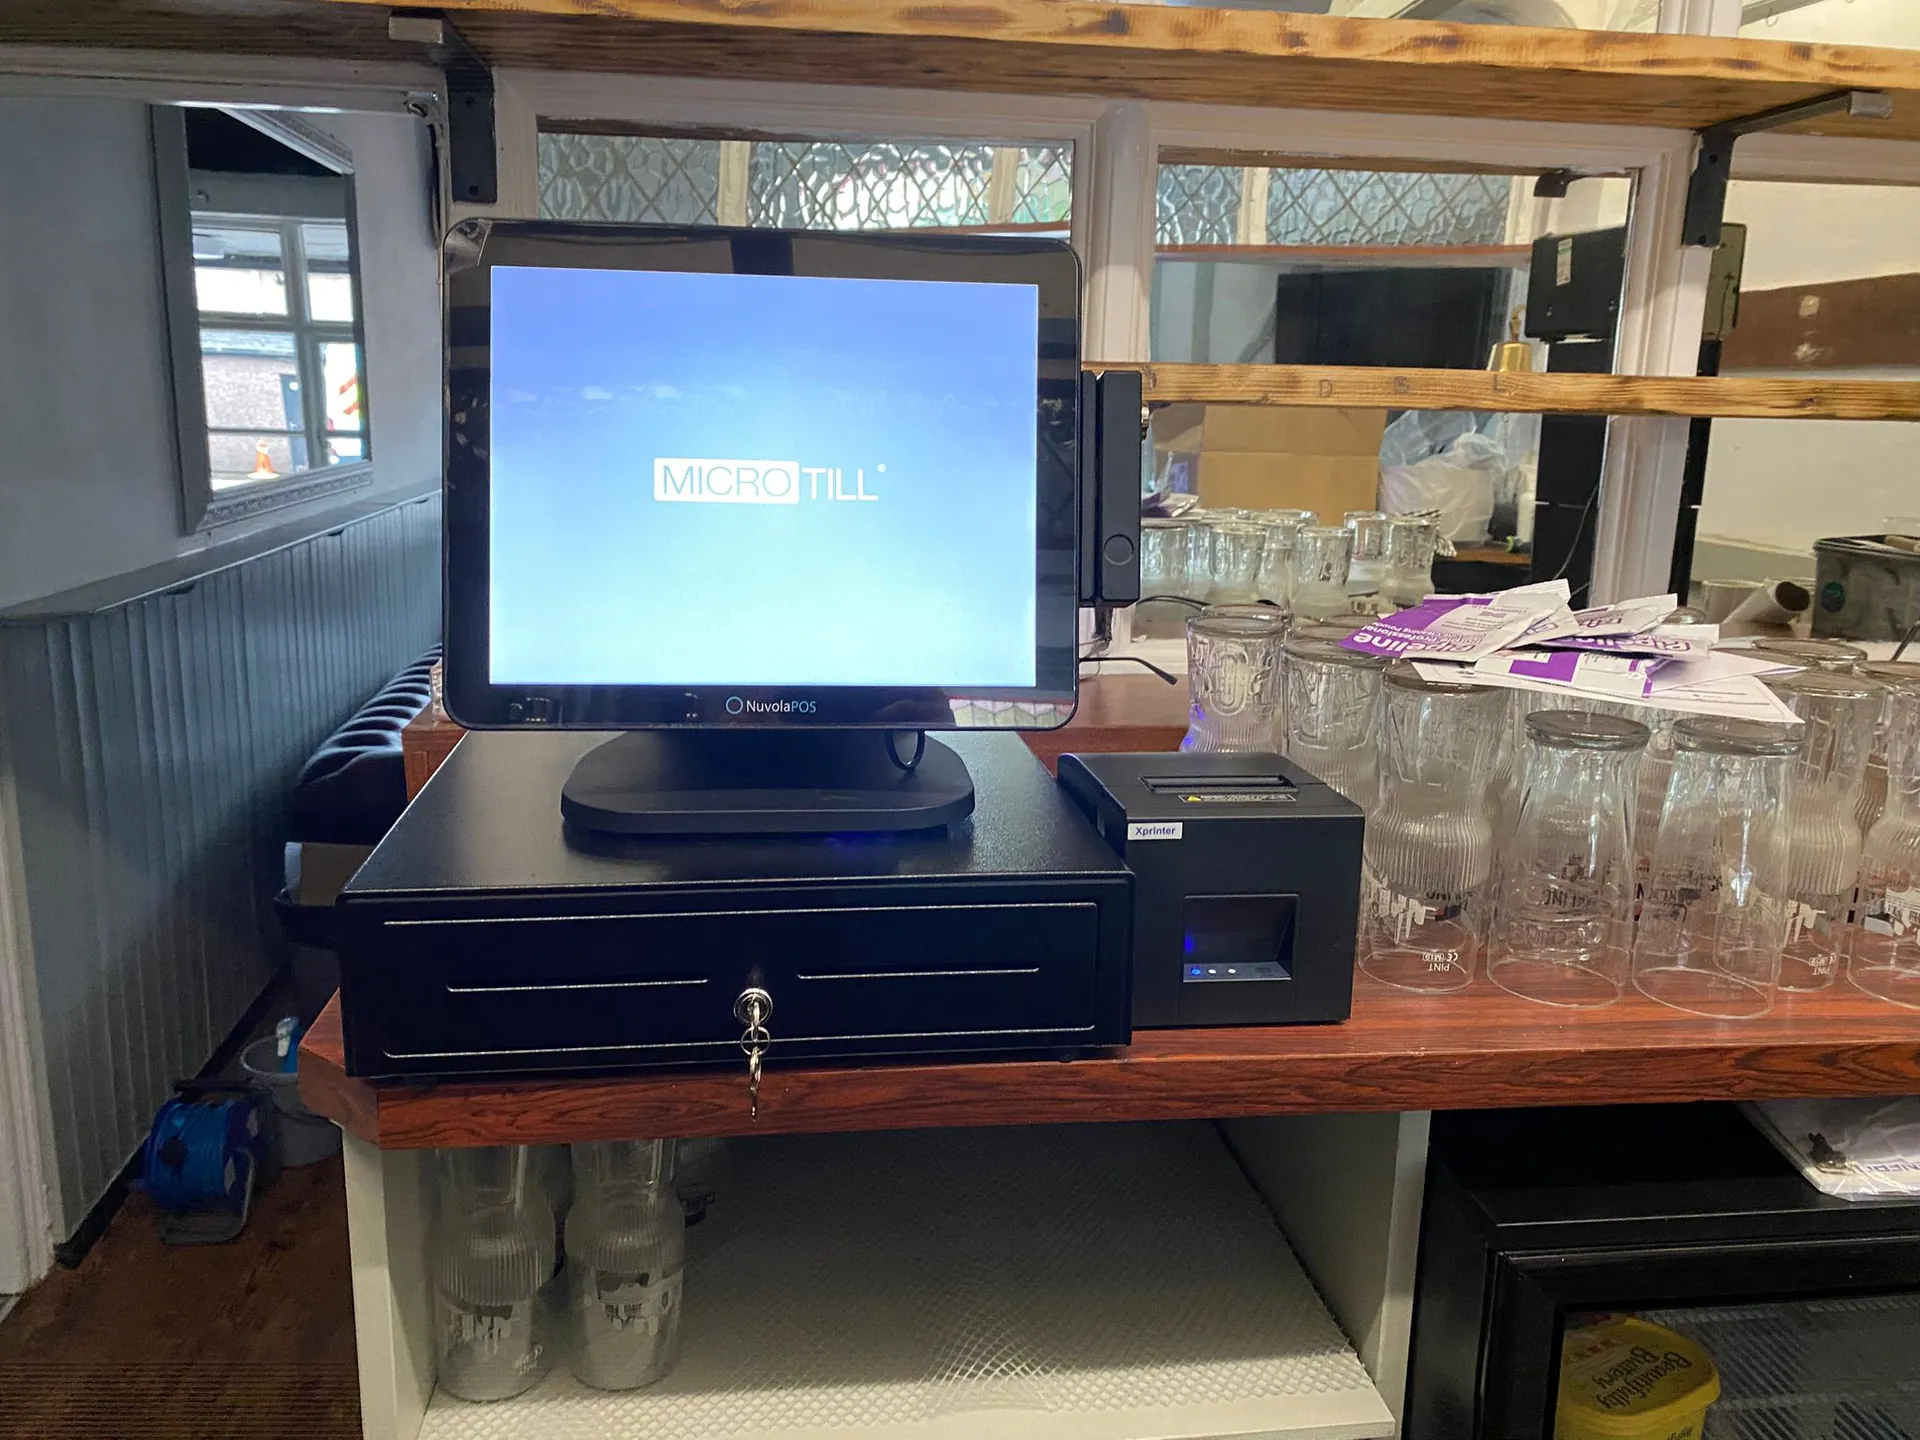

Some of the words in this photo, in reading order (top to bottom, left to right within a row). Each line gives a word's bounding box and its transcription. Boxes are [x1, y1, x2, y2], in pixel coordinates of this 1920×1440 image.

[1352, 631, 1477, 653] Pipeline
[1361, 624, 1438, 643] Professional
[745, 699, 817, 714] NuvolaPOS
[1135, 826, 1176, 837] Xprinter
[1427, 962, 1450, 972] PINT
[1591, 1344, 1661, 1390] Buttery
[1595, 1351, 1693, 1410] Beautifully
